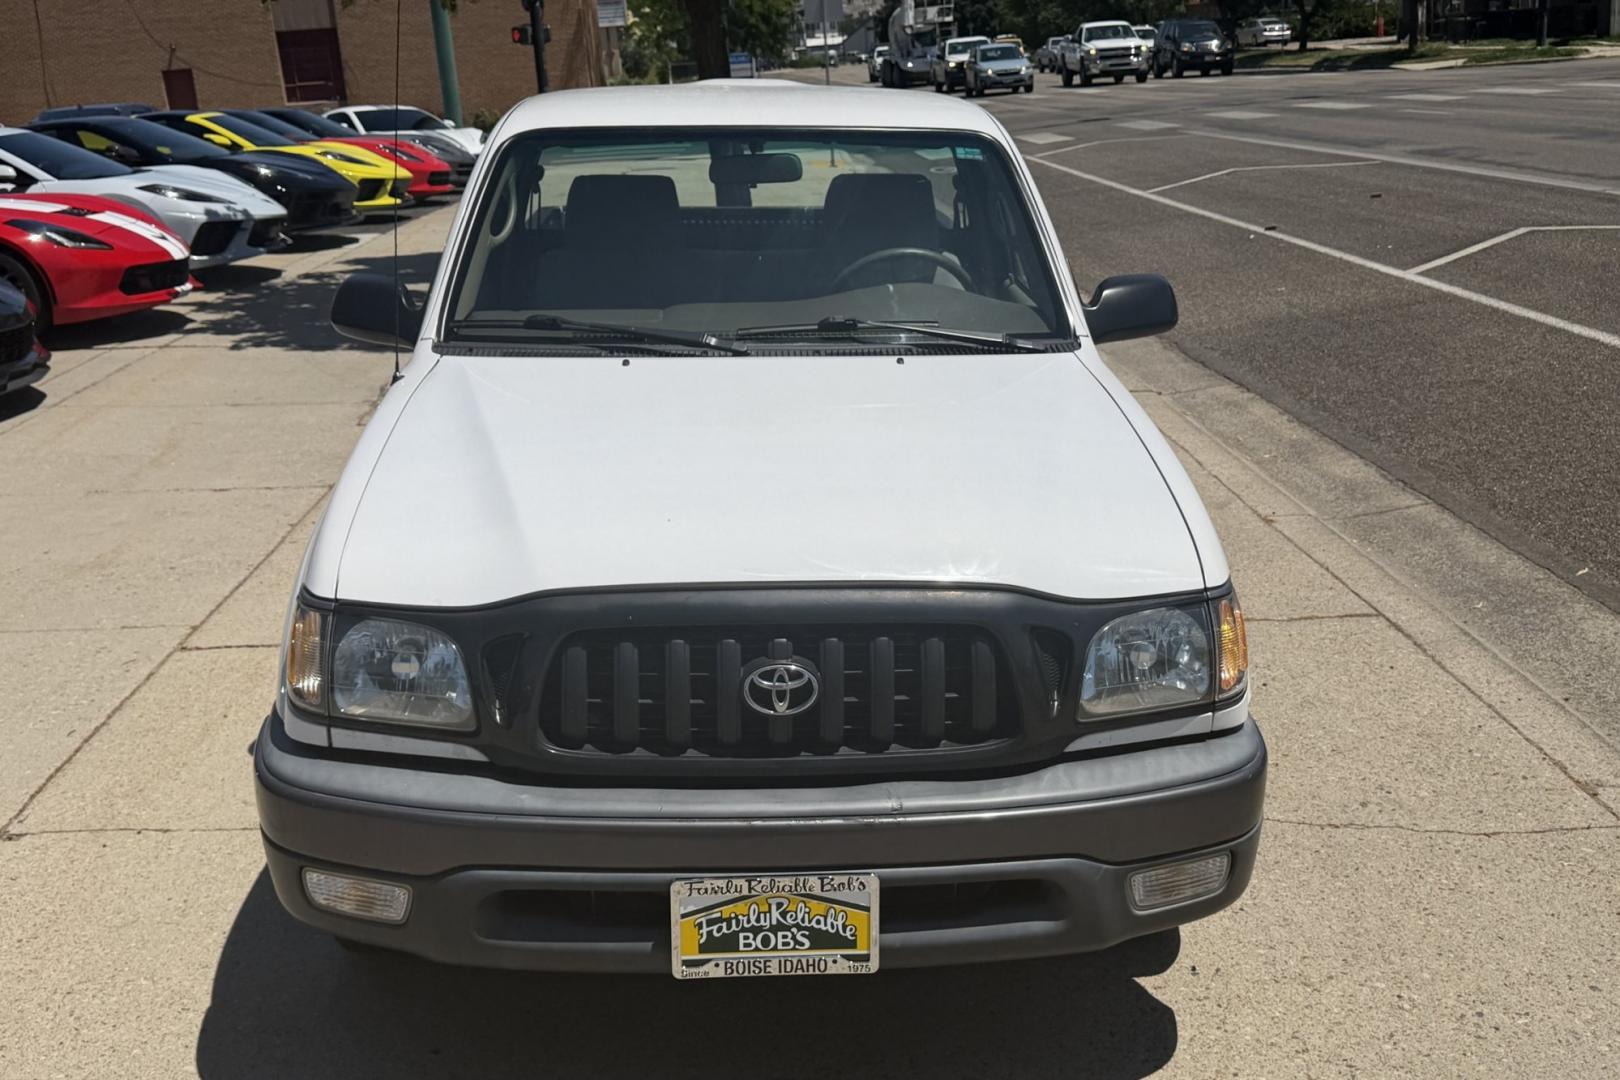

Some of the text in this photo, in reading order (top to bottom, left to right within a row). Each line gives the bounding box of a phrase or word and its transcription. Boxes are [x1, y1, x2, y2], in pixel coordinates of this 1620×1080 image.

[686, 876, 866, 897] Fairly Reliable Bob's
[694, 897, 857, 943] Fairly Reliable
[738, 927, 811, 951] BOB'S
[681, 969, 709, 978] Since
[724, 958, 828, 976] BOISE IDAHO
[847, 964, 871, 973] 1975
